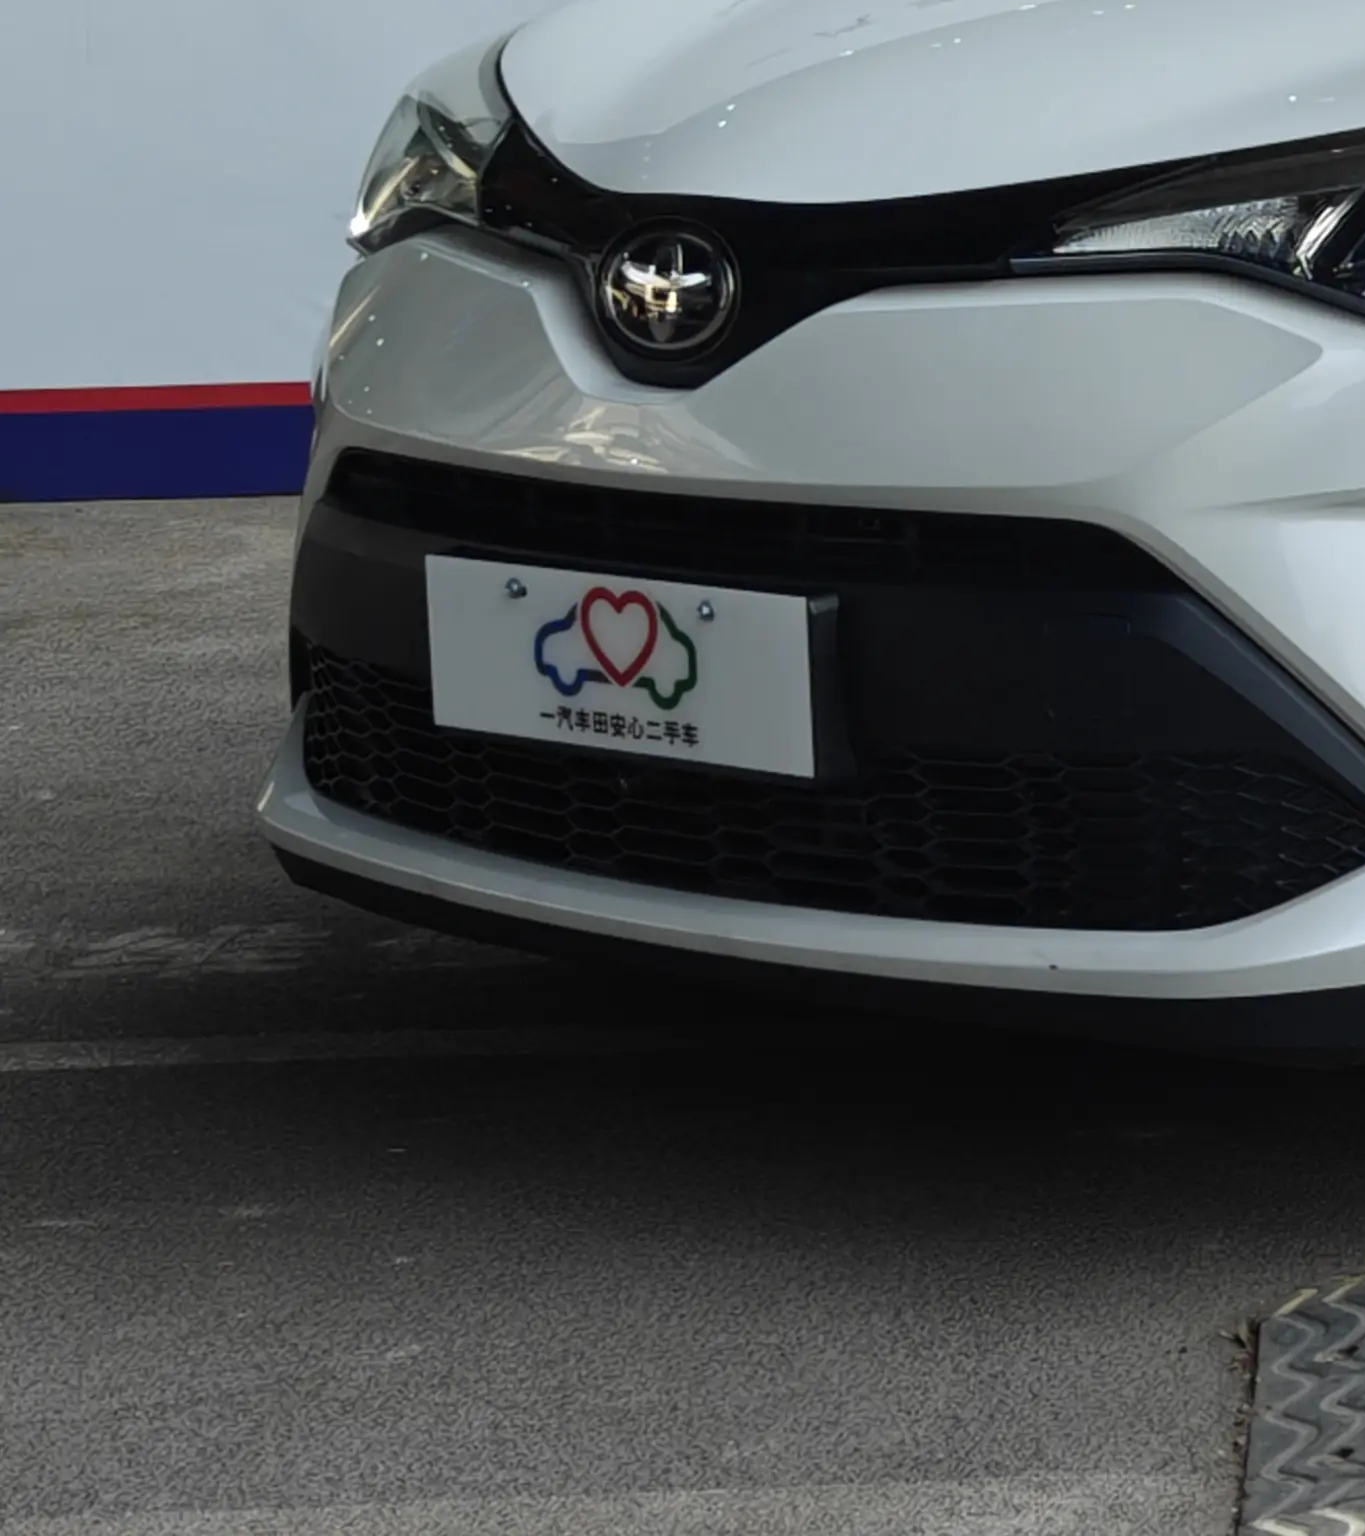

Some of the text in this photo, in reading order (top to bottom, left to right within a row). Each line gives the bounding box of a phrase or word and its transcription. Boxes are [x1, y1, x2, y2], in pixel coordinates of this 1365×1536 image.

[540, 705, 699, 748] 一汽丰田安心二手车
